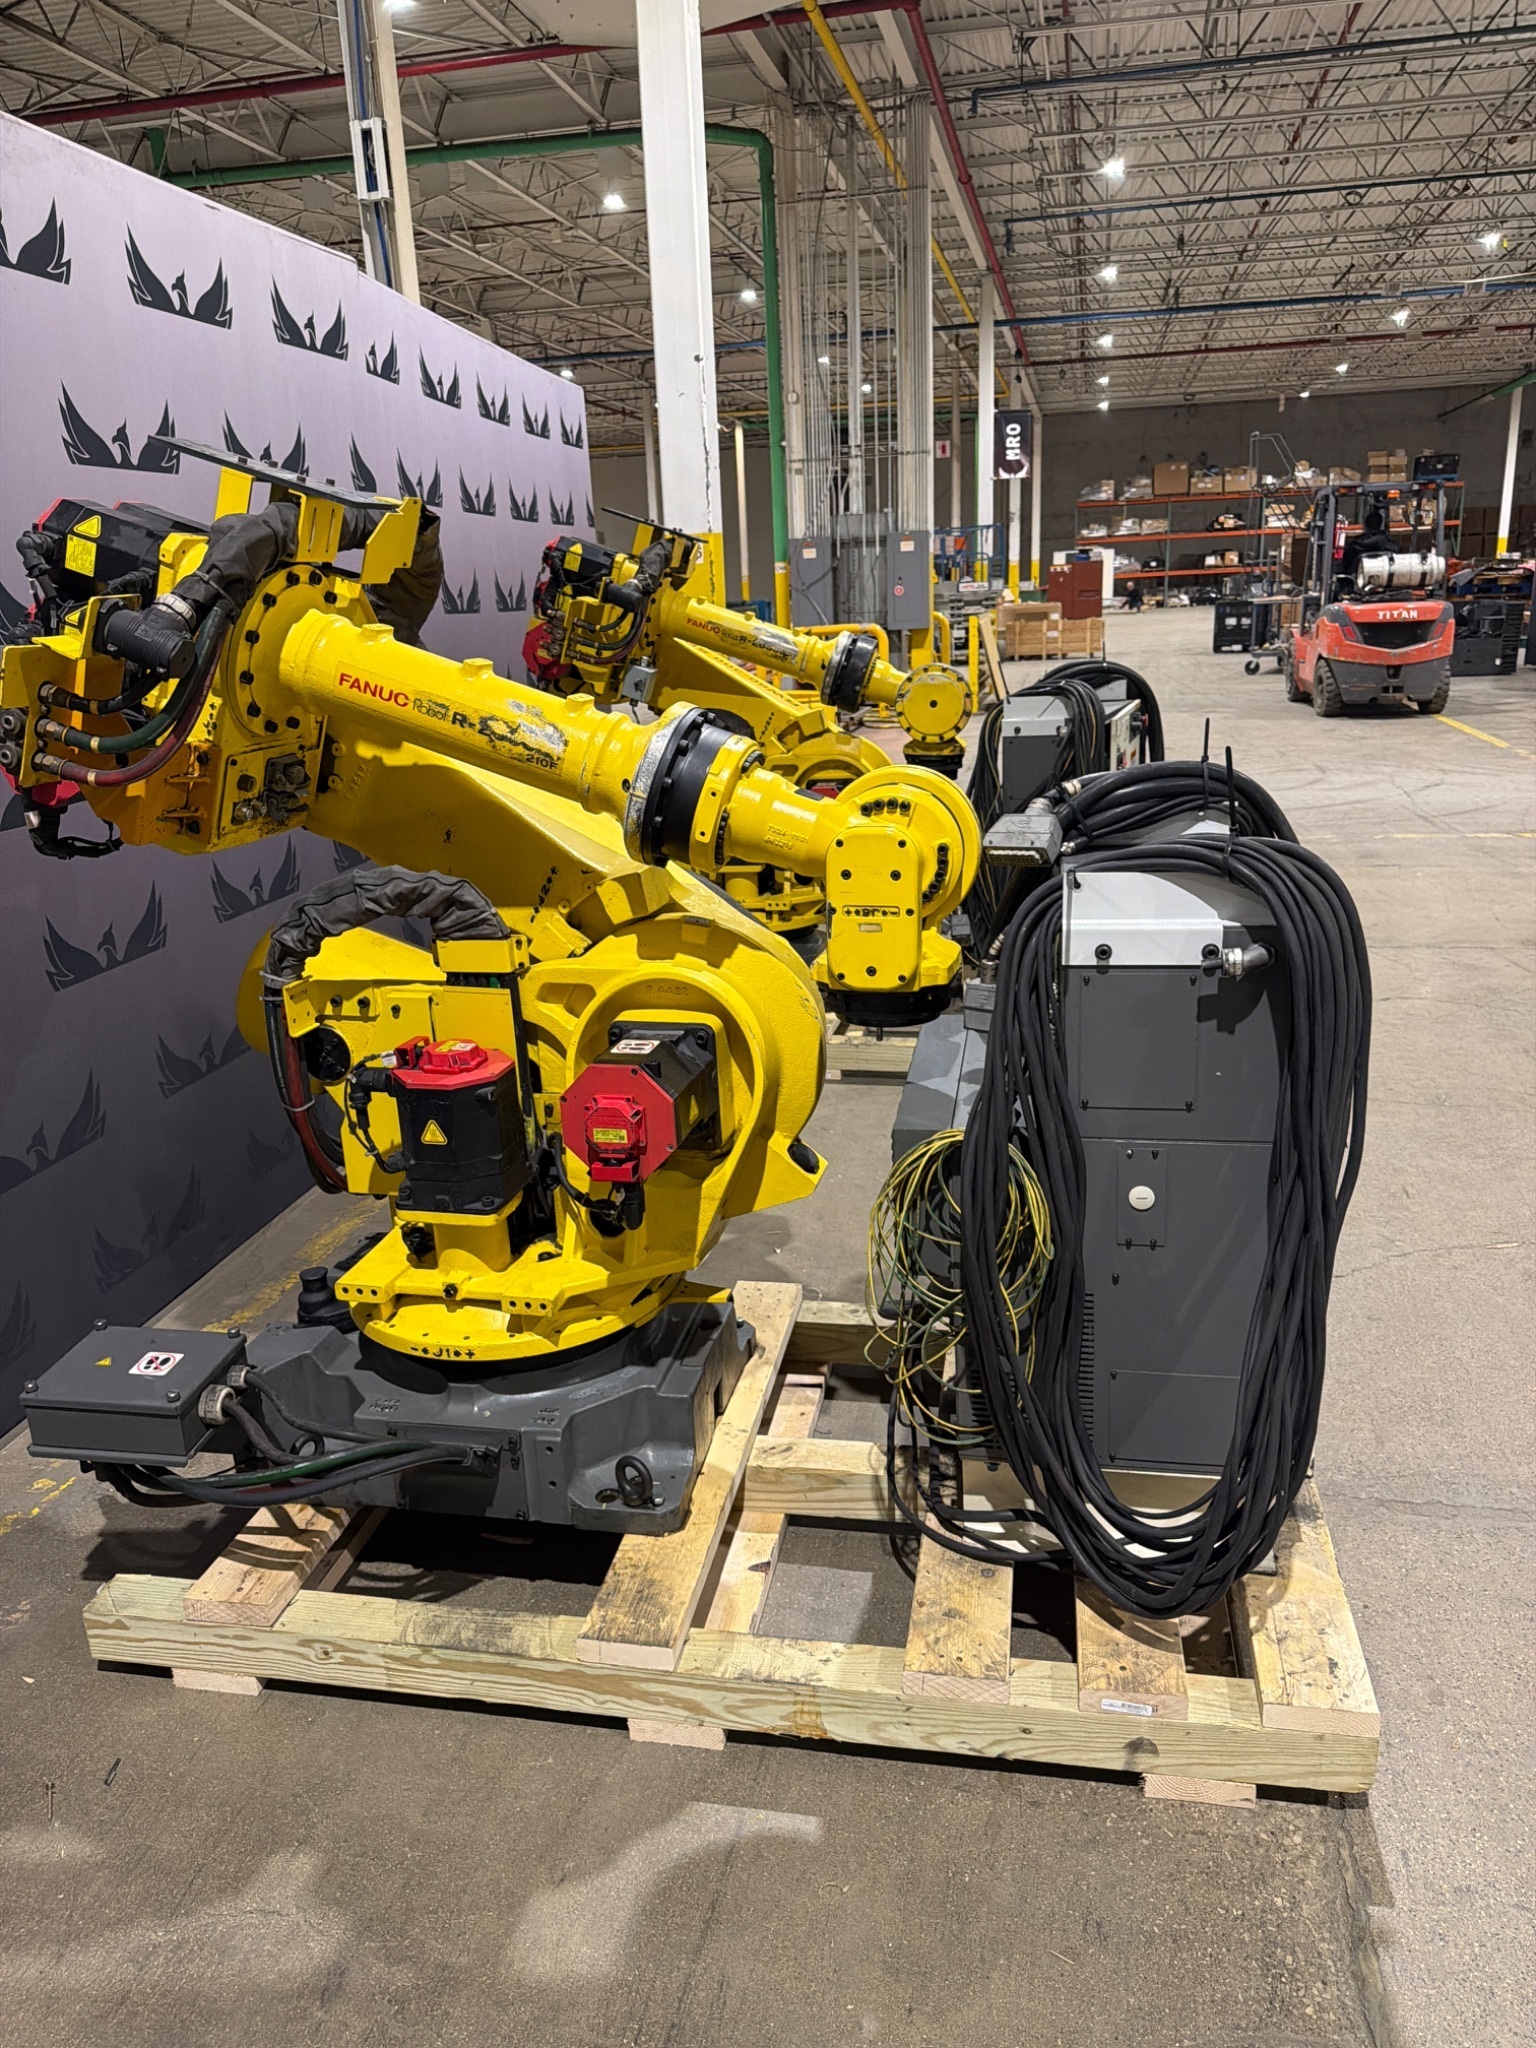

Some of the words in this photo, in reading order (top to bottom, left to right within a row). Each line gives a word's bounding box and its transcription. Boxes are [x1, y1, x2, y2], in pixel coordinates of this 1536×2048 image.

[1005, 422, 1021, 461] MRO
[1377, 608, 1418, 620] TITAN
[687, 618, 720, 634] FANUC
[338, 672, 410, 708] FANUC
[412, 697, 449, 721] Robot
[525, 754, 559, 770] 210F
